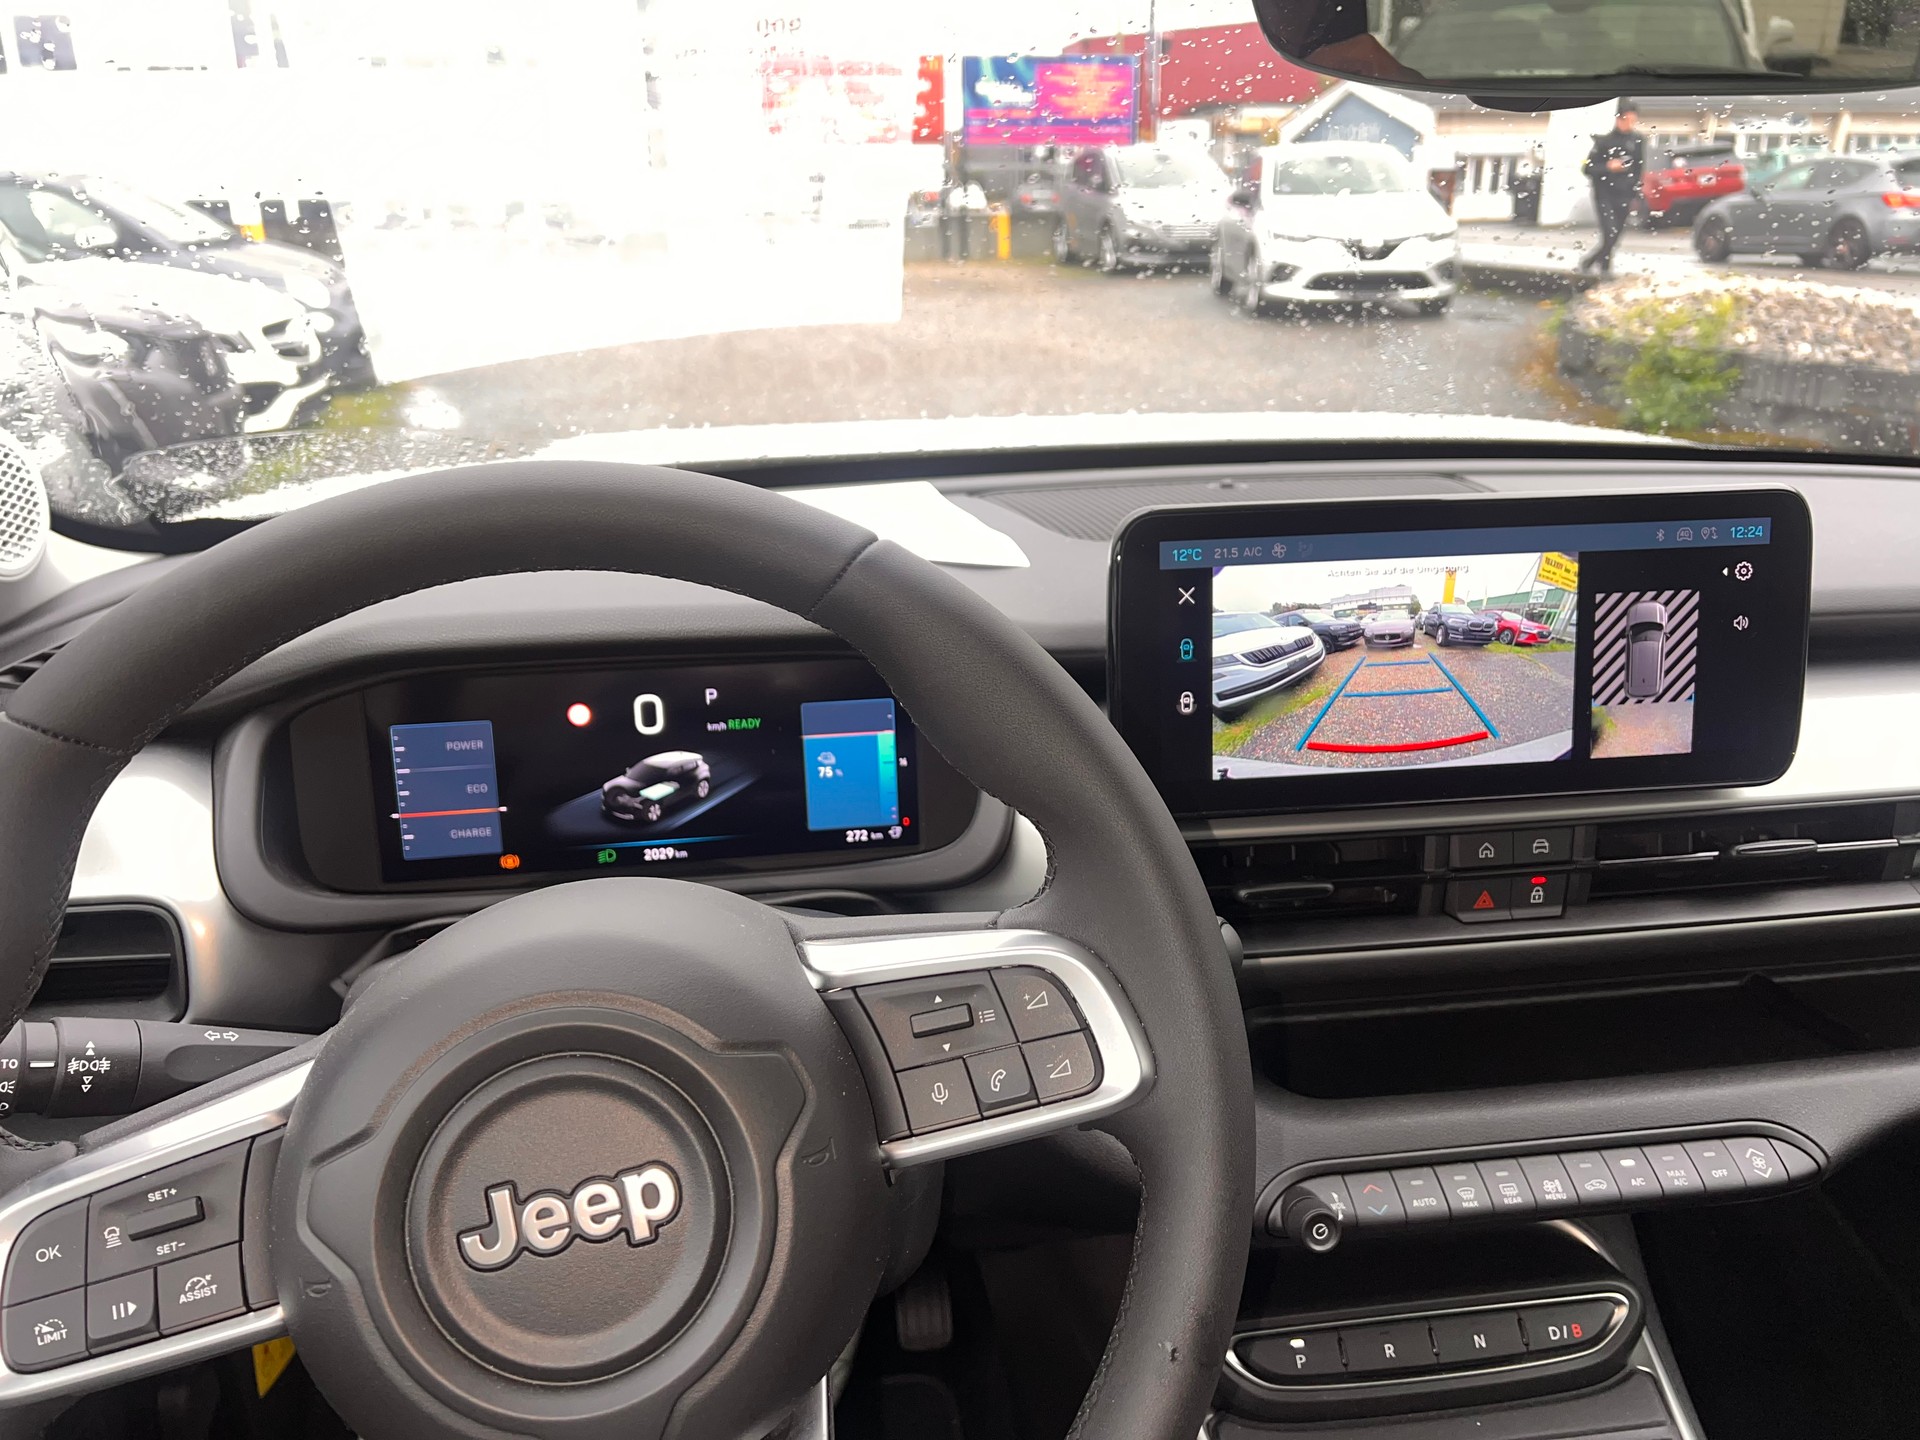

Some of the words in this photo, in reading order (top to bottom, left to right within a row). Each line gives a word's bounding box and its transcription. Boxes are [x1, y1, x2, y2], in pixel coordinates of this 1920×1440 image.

[1730, 526, 1763, 538] 12:24
[1172, 548, 1202, 561] 12°C
[1214, 548, 1239, 559] 21.5
[1243, 546, 1263, 557] A/C
[705, 688, 717, 705] P
[633, 693, 664, 735] 0
[707, 722, 727, 731] km/h
[728, 718, 761, 730] READY
[446, 740, 484, 751] POWER
[817, 766, 833, 778] 75
[465, 783, 488, 794] ECO
[450, 827, 492, 839] CHARGE
[845, 829, 868, 842] 272
[870, 832, 884, 840] km
[644, 847, 674, 861] 2029
[675, 850, 688, 858] km
[1666, 1170, 1685, 1178] MAX
[1712, 1169, 1728, 1178] OFF
[1631, 1177, 1646, 1186] A/C
[1674, 1177, 1689, 1186] A/C
[147, 1187, 177, 1202] SET+
[1503, 1196, 1522, 1204] REAR
[1545, 1192, 1567, 1200] MENU
[1330, 1202, 1346, 1210] VOL
[1413, 1197, 1437, 1207] AUTO
[1462, 1200, 1479, 1208] MAX
[461, 1167, 676, 1266] Jeep
[35, 1244, 62, 1262] OK
[179, 1285, 218, 1304] ASSIST
[37, 1328, 68, 1346] LIMIT
[1474, 1334, 1487, 1348] N
[1384, 1344, 1396, 1358] R
[1295, 1354, 1306, 1368] P
